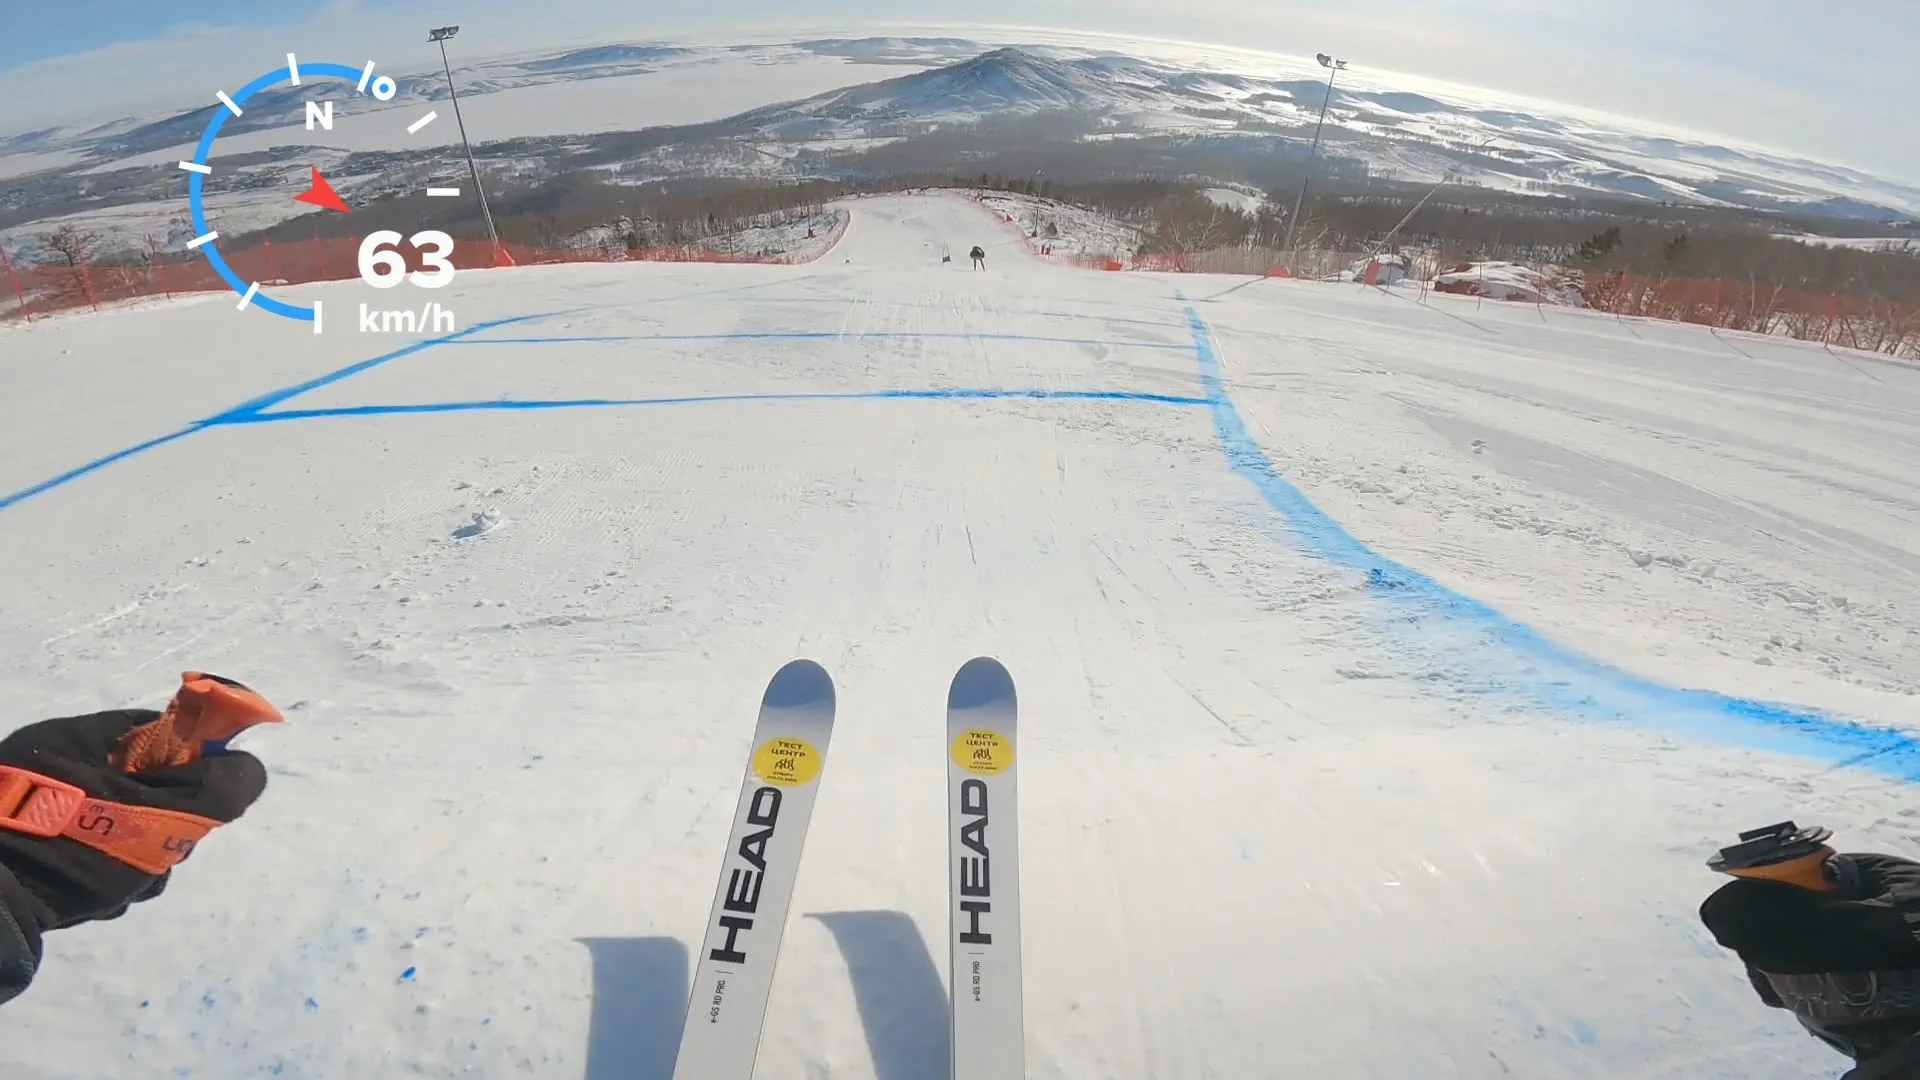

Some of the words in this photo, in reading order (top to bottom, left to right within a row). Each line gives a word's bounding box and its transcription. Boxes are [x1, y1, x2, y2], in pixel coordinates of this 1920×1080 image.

[778, 740, 803, 750] ТЕСТ
[966, 739, 998, 747] ЦЕНТР
[771, 748, 806, 757] ЦЕНТР
[960, 778, 992, 945] HEAD
[709, 786, 783, 964] HEAD
[715, 980, 726, 994] PRO
